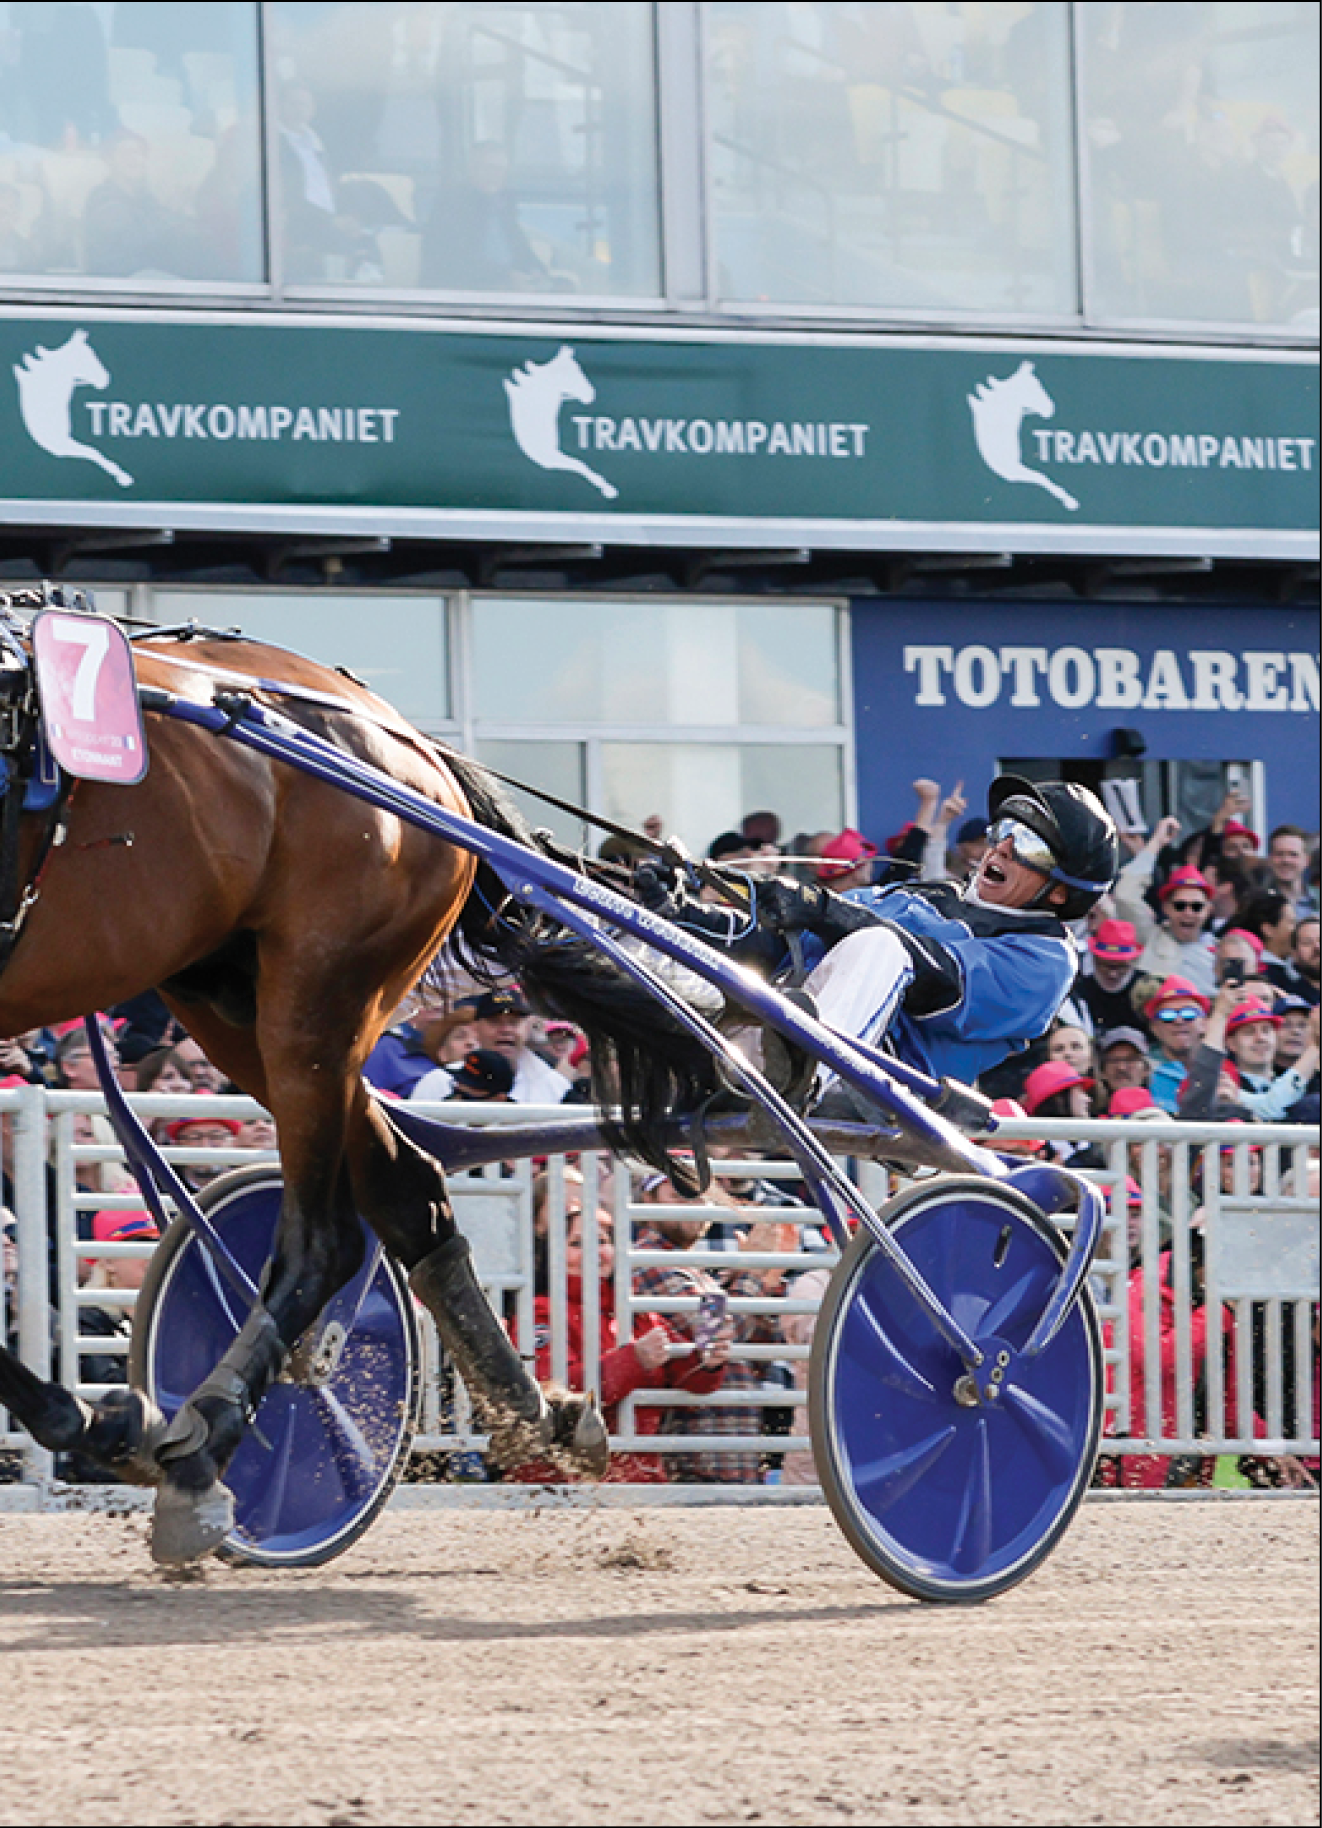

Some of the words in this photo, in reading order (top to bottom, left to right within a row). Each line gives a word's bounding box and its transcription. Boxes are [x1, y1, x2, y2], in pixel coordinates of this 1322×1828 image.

[84, 401, 400, 443] TRAVKOMPANIET
[572, 416, 870, 457] TRAVKOMPANIET
[1032, 429, 1315, 471] TRAVKOMPANIET
[52, 619, 109, 722] 7
[904, 645, 1320, 712] TOTOBAREN
